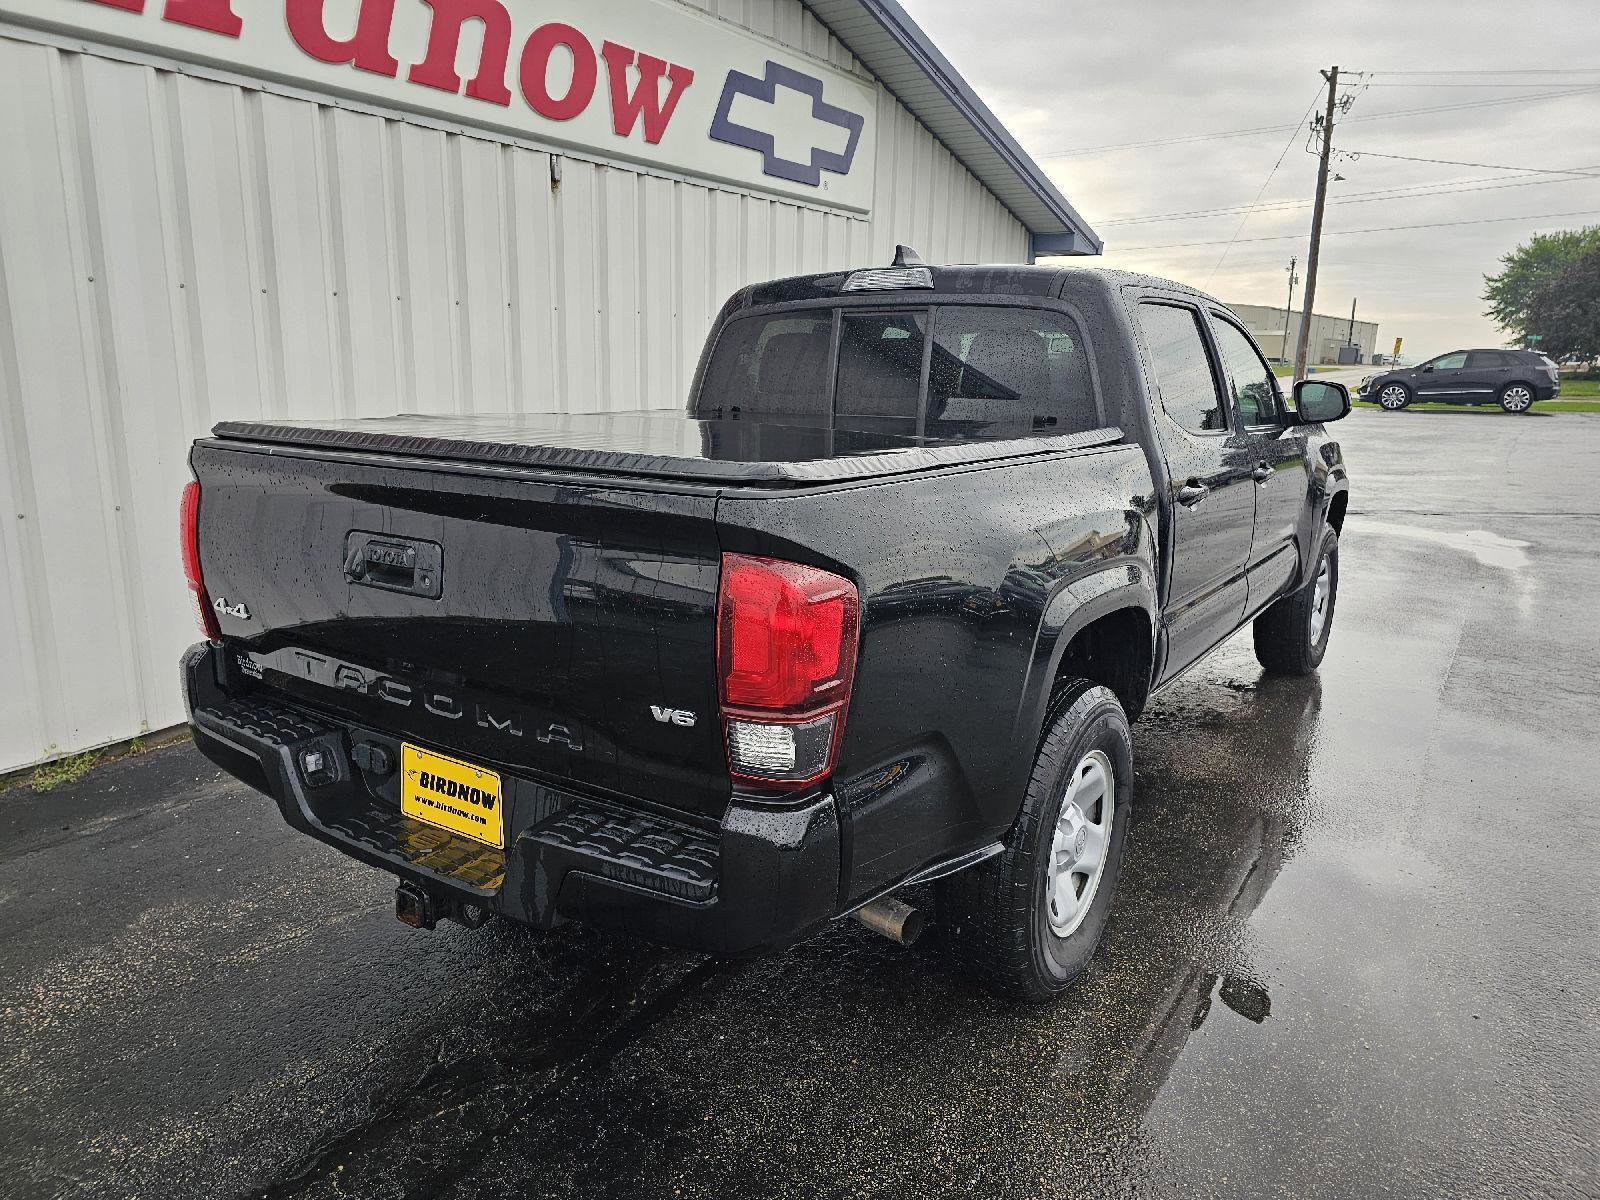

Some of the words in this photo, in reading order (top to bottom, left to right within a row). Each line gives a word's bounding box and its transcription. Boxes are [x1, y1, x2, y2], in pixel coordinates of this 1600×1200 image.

[83, 0, 695, 145] now
[294, 650, 584, 751] TACOMA
[650, 705, 697, 727] V6
[414, 794, 487, 826] www.birdnow.com
[420, 770, 497, 811] BIRDNOW
